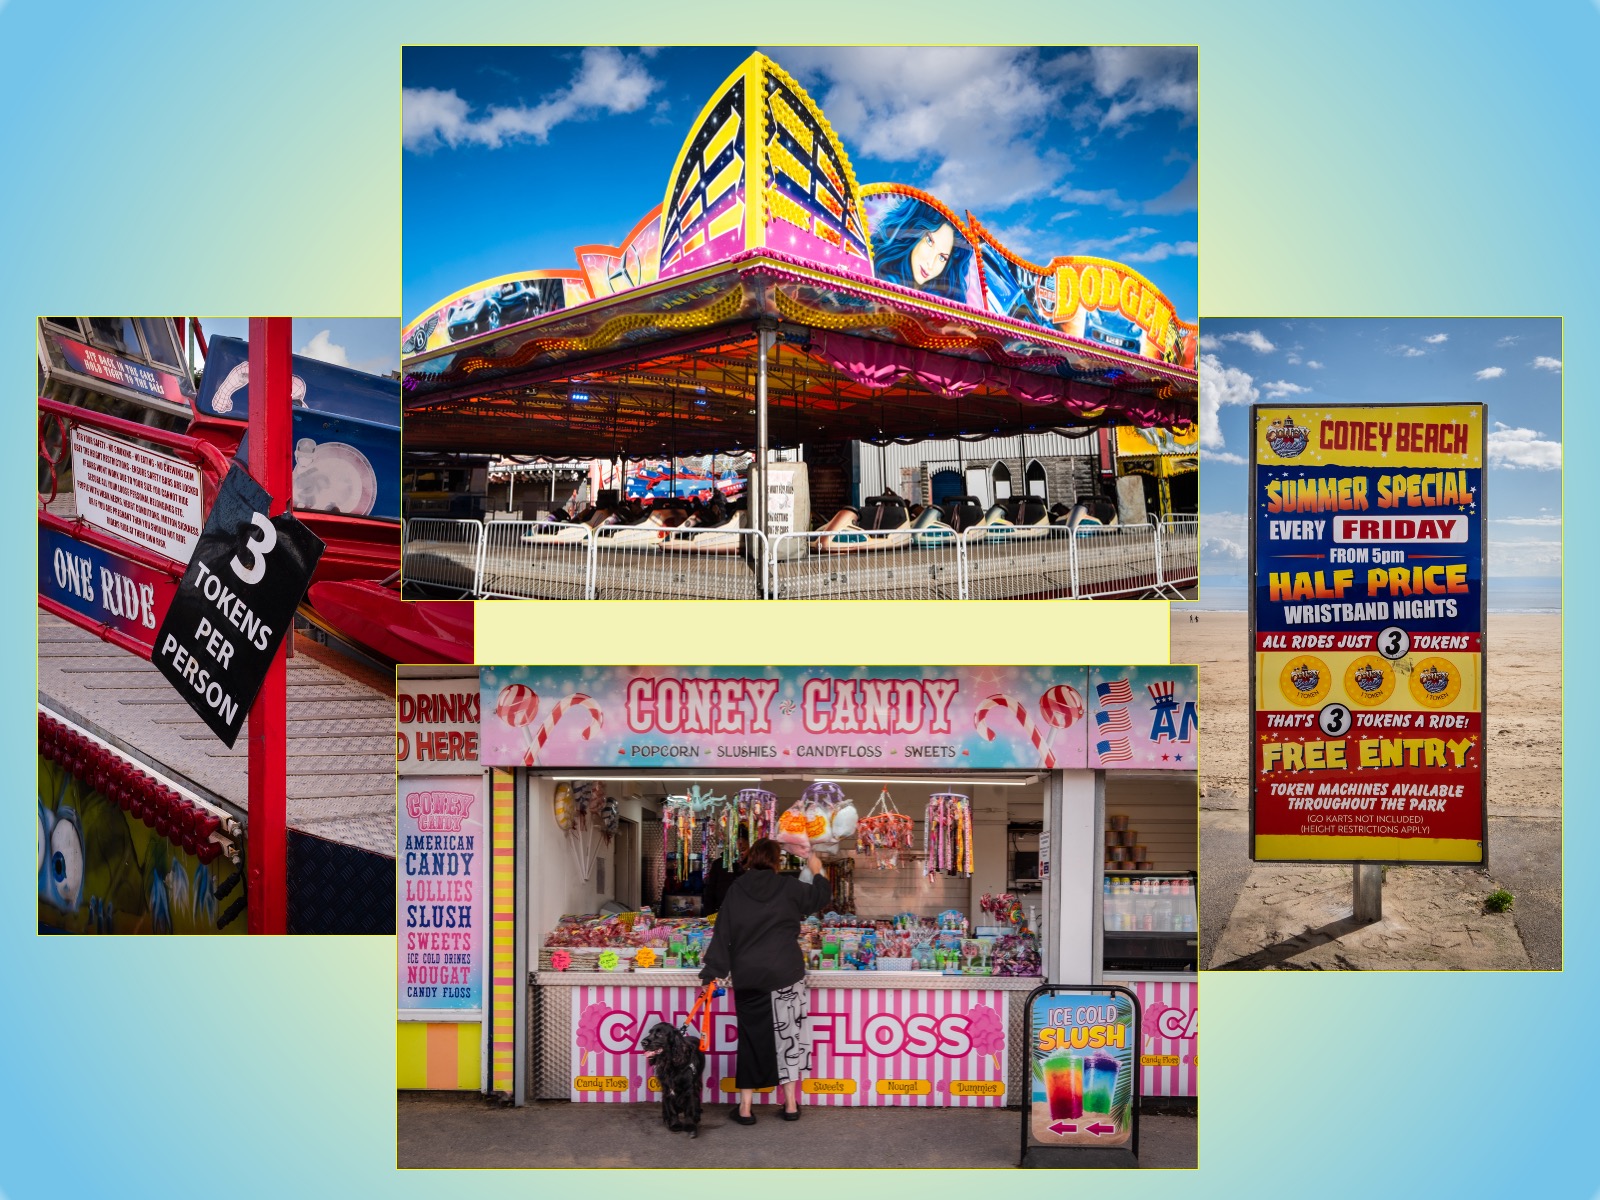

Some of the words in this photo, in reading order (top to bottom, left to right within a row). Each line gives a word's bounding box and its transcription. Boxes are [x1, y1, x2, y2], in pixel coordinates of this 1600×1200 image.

[1054, 265, 1173, 354] DODGEM
[1320, 420, 1393, 452] CONEY
[1396, 422, 1469, 454] BEACH
[1267, 475, 1369, 513] SUMMER
[1377, 470, 1473, 508] SPECIAL
[1269, 520, 1326, 540] EVERY
[1342, 519, 1457, 540] FRIDAY
[230, 511, 277, 585] 3
[1330, 548, 1369, 563] FROM
[1372, 548, 1405, 564] 5pm
[54, 547, 94, 602] ONE
[100, 566, 156, 629] RIDE
[1269, 569, 1354, 602] HALF
[1368, 564, 1469, 597] PRICE
[194, 561, 273, 651] TOKENS
[1284, 603, 1390, 625] WRISTBAND
[1394, 598, 1458, 620] NIGHTS
[195, 617, 236, 671] PER
[1262, 634, 1287, 649] ALL
[1291, 634, 1334, 649] RIDES
[1337, 634, 1373, 649] JUST
[1386, 630, 1402, 655] 3
[1414, 635, 1470, 650] TOKENS
[161, 633, 239, 726] PERSON
[624, 677, 780, 736] CONEY
[801, 677, 959, 736] CANDY
[1267, 714, 1314, 728] THAT'S
[1327, 708, 1344, 733] 3
[1356, 714, 1412, 728] TOKENS
[1415, 714, 1425, 728] A
[1429, 714, 1470, 729] RIDE!
[416, 731, 478, 761] HERE
[630, 745, 700, 758] POPCORN
[716, 745, 778, 758] SLUSHIES
[796, 746, 883, 758] CANDYFLOSS
[904, 746, 956, 758] SWEETS
[1262, 739, 1348, 772] FREE
[1358, 737, 1472, 769] ENTRY
[1270, 782, 1316, 797] TOKEN
[1318, 782, 1389, 797] MACHINES
[1392, 783, 1464, 798] AVAILABLE
[406, 790, 474, 819] CONEY
[1288, 798, 1377, 811] THROUGHOUT
[1380, 798, 1405, 811] THE
[1409, 798, 1447, 812] PARK
[418, 814, 462, 832] CANDY
[1300, 824, 1336, 834] (HEIGHT
[1338, 825, 1399, 834] RESTRICTIONS
[1400, 826, 1430, 835] APPLY)
[1307, 814, 1324, 824] (GO
[1326, 814, 1353, 823] KARTS
[1355, 814, 1374, 823] NOT
[1376, 814, 1424, 824] INCLUDED)
[405, 835, 474, 850] AMERICAN
[406, 852, 474, 876] CANDY
[406, 880, 473, 902] LOLLIES
[406, 905, 472, 928] SLUSH
[407, 932, 471, 951] SWEETS
[407, 953, 419, 964] ICE
[422, 953, 440, 964] COLD
[444, 953, 471, 964] DRINKS
[407, 966, 471, 985] NOUGAT
[407, 986, 438, 998] CANDY
[442, 987, 471, 998] FLOSS
[1048, 1006, 1073, 1026] ICE
[1076, 1004, 1118, 1024] COLD
[808, 1012, 973, 1059] FLOSS
[1038, 1024, 1126, 1051] SLUSH
[576, 1078, 604, 1091] Candy
[604, 1078, 628, 1090] Floss
[813, 1080, 844, 1093] Sweets
[887, 1080, 918, 1094] Nougat
[956, 1082, 998, 1094] Dummies
